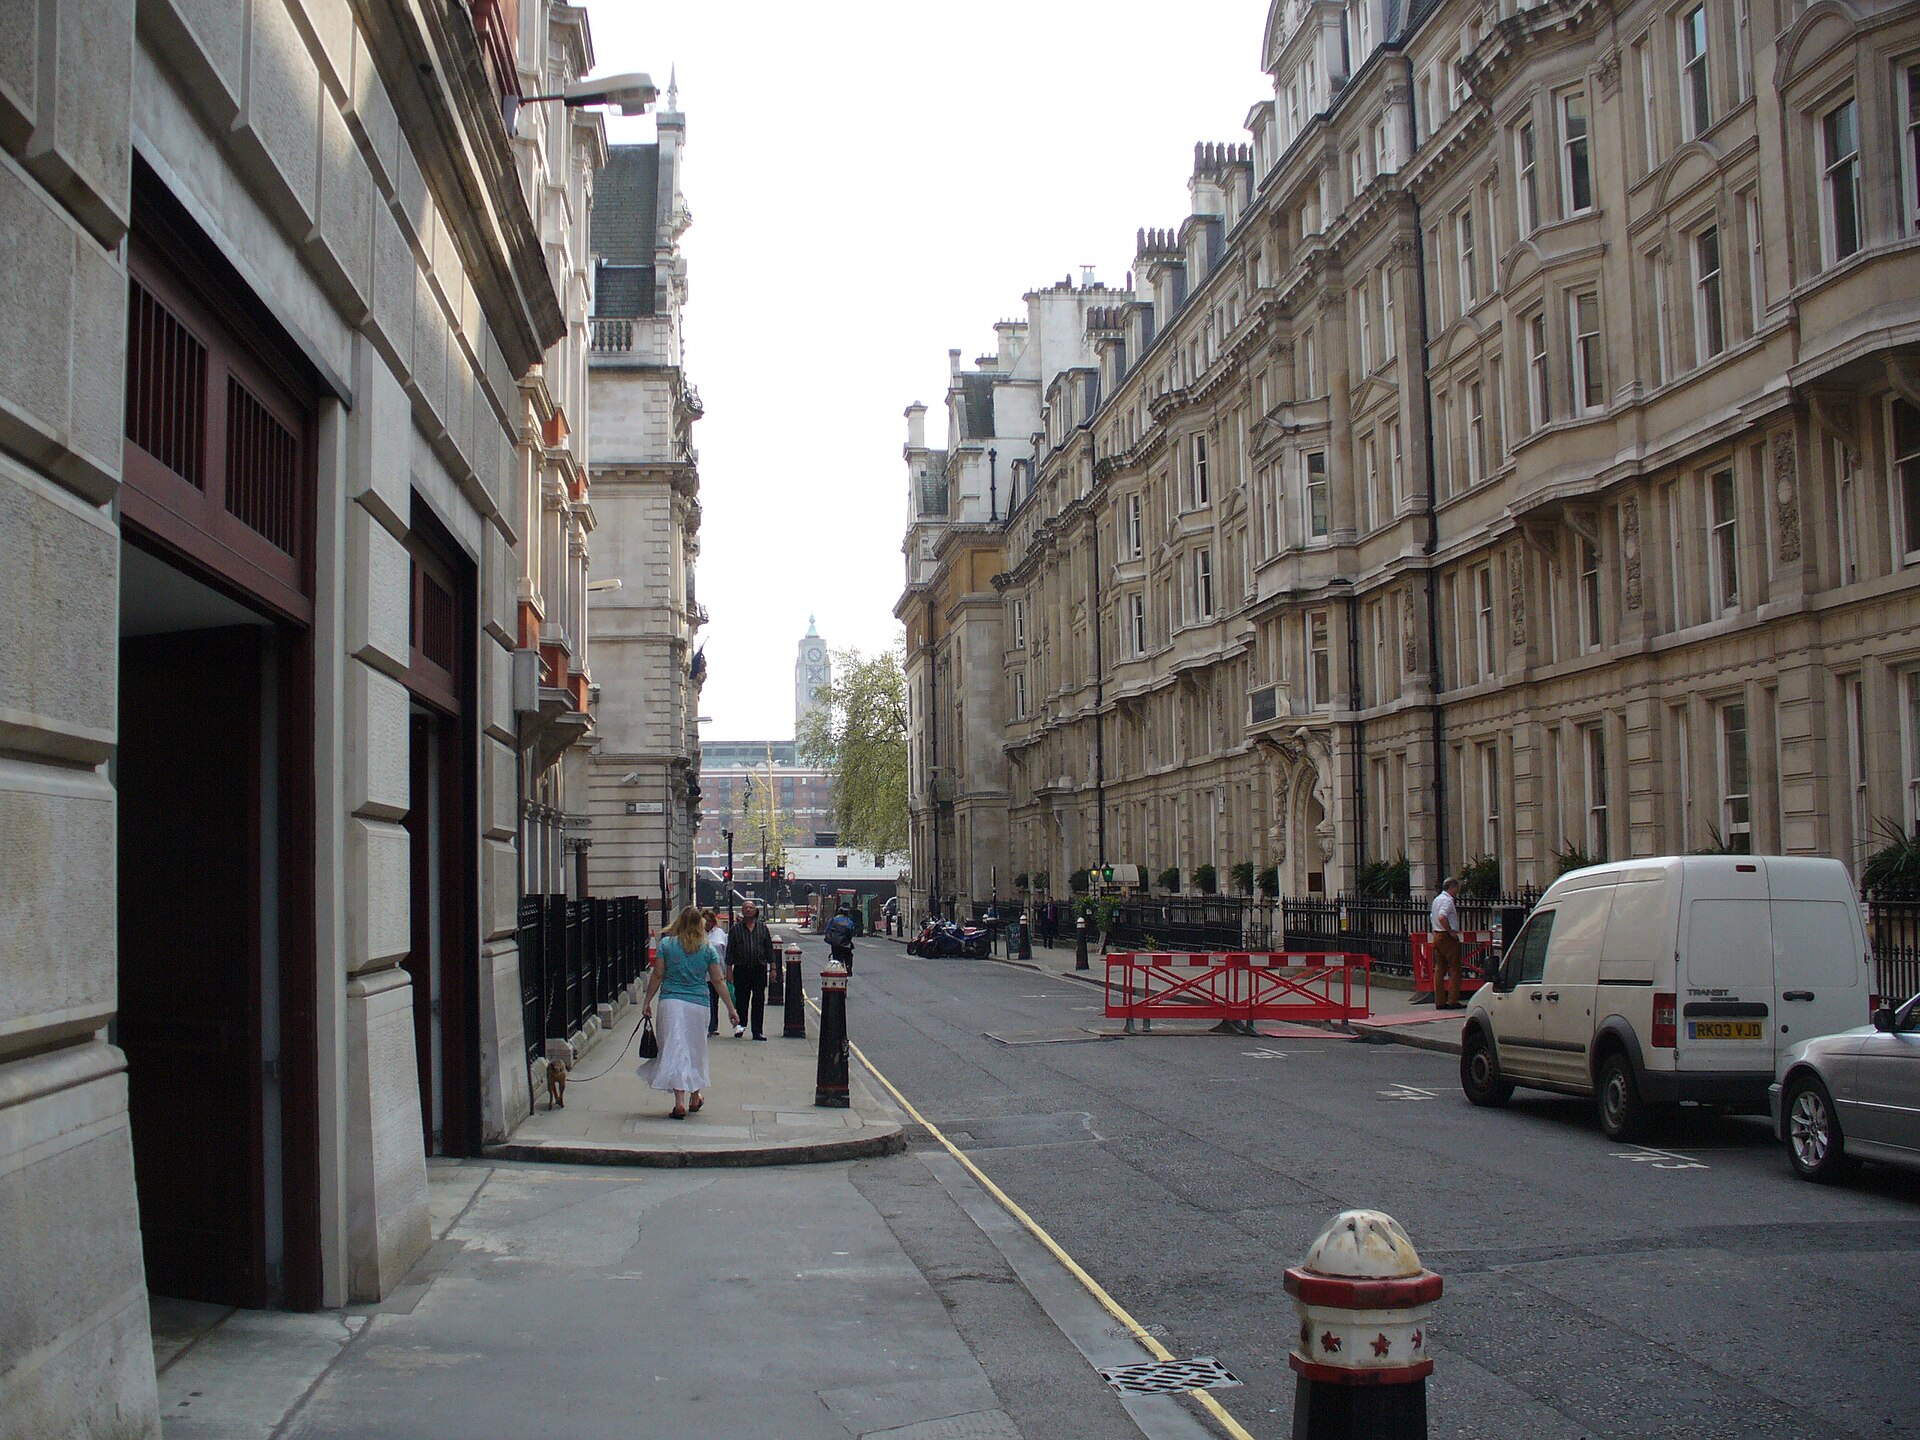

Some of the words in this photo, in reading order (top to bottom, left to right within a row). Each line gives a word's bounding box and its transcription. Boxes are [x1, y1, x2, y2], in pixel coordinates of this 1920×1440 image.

[1687, 988, 1729, 997] TRANSIT
[1697, 1023, 1732, 1037] RK03
[1735, 1023, 1761, 1037] VJD
